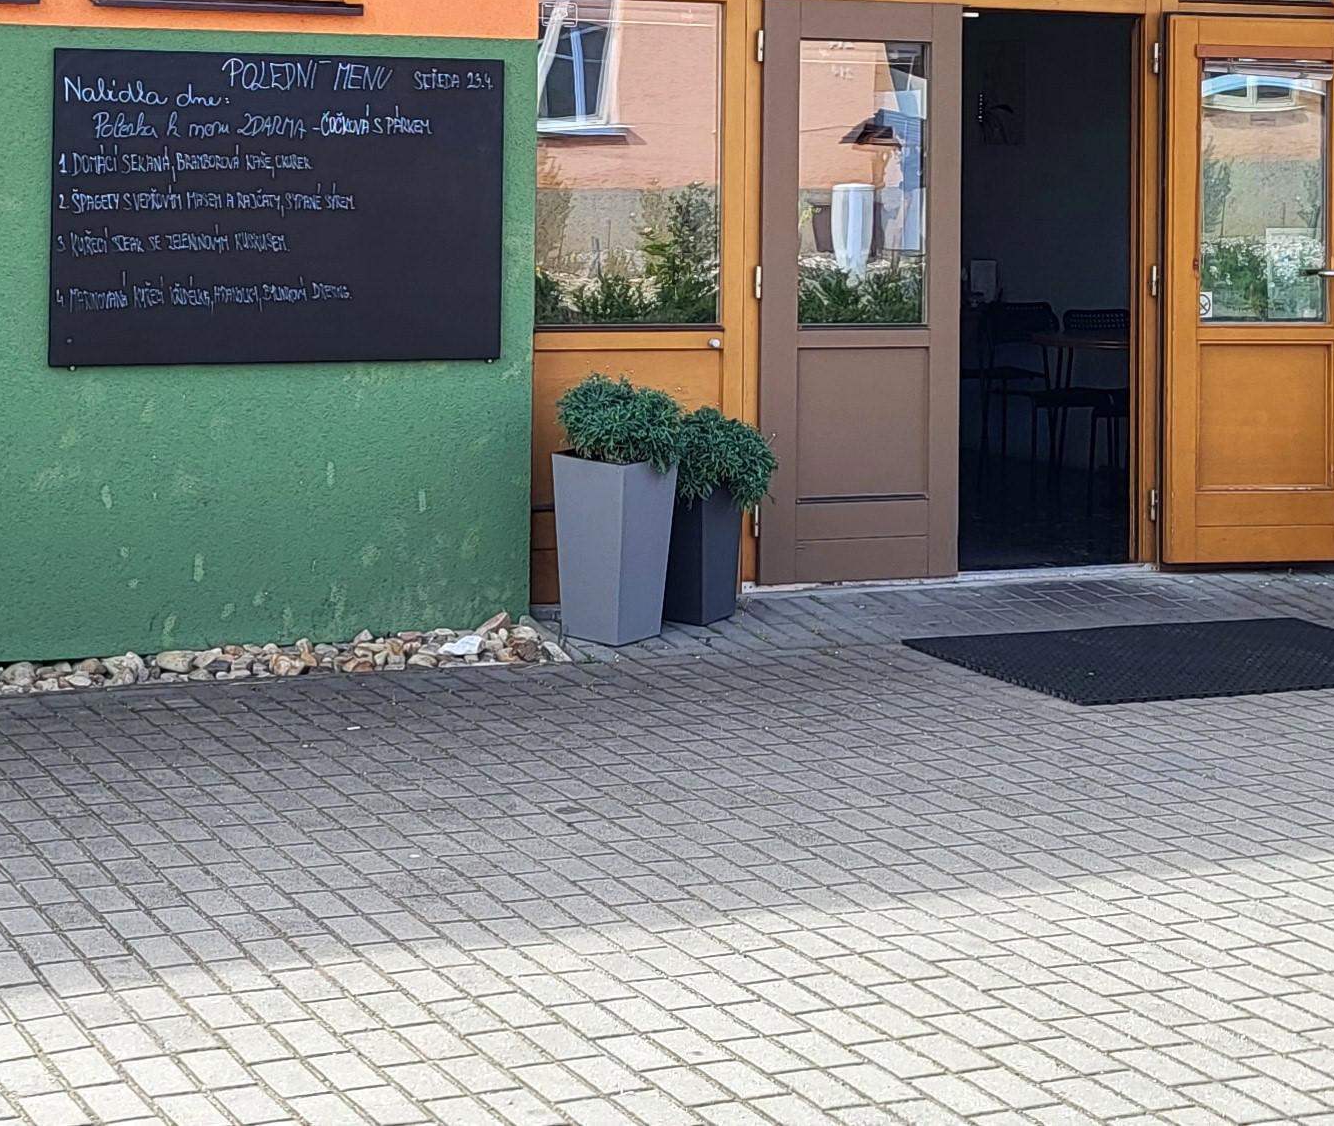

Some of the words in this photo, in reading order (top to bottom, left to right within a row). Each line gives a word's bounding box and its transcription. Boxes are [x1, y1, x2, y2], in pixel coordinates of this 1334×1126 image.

[333, 62, 393, 91] MENU
[176, 83, 231, 107] dne:
[166, 110, 182, 138] k
[236, 112, 307, 139] ZDARMA
[372, 118, 384, 135] S
[71, 188, 120, 214] ŠPAGETY
[122, 192, 133, 211] S
[186, 190, 223, 211] MASEM
[226, 192, 235, 210] A
[148, 234, 162, 251] SE
